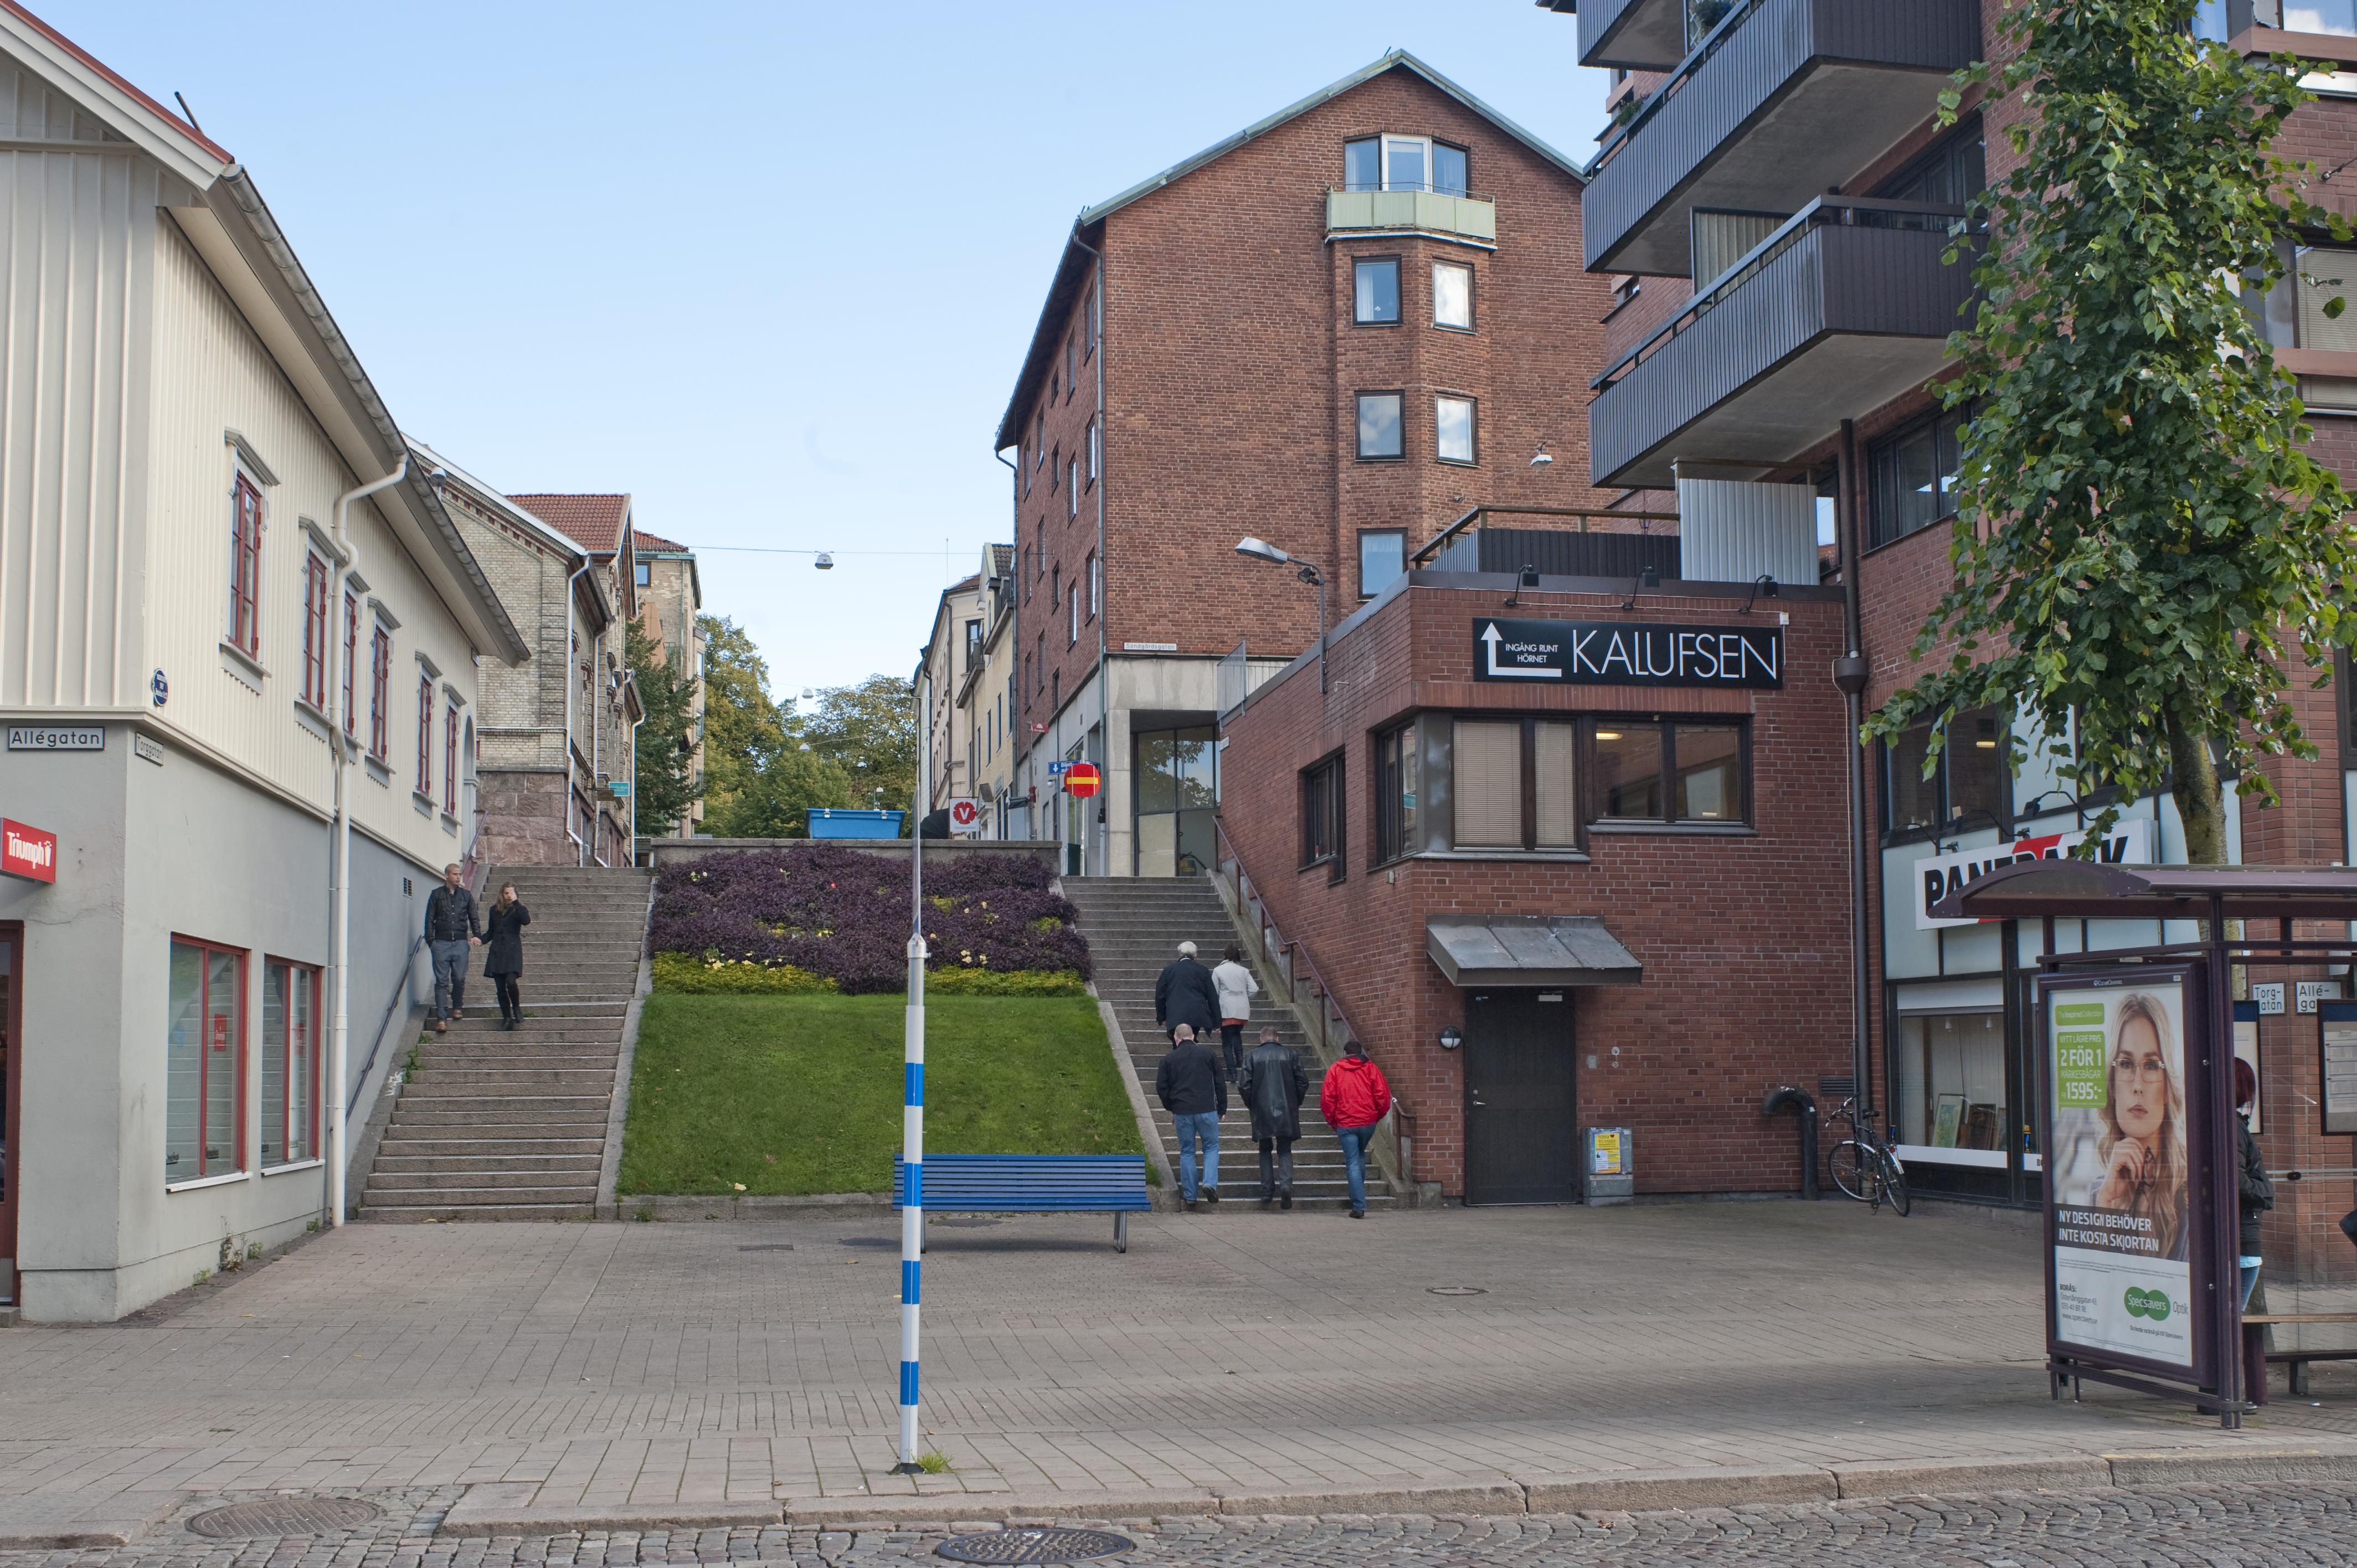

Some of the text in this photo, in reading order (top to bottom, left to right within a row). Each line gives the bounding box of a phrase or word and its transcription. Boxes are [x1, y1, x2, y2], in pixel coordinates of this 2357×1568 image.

[1505, 642, 1537, 652] INGÅNG
[1573, 629, 1777, 680] KALUFSEN
[1517, 653, 1547, 663] HÖRNET
[12, 730, 100, 747] Allégatan
[137, 736, 162, 762] Torggatan
[7, 831, 44, 869] Triumph
[2255, 987, 2281, 1000] Torg-
[2299, 984, 2330, 997] Allé-
[2261, 1001, 2282, 1011] atan
[2073, 1034, 2088, 1043] LÄGRE
[2060, 1045, 2101, 1066] 2 FÖR 1
[2061, 1067, 2101, 1079] MÄRKESBÅGAR
[2066, 1082, 2102, 1100] 1595:-
[2058, 1210, 2152, 1232] NY DESIGN BEHÖVER
[2058, 1227, 2159, 1252] INTE KOSTA SKJORTAN
[2128, 1294, 2188, 1315] Specsavers Optik
